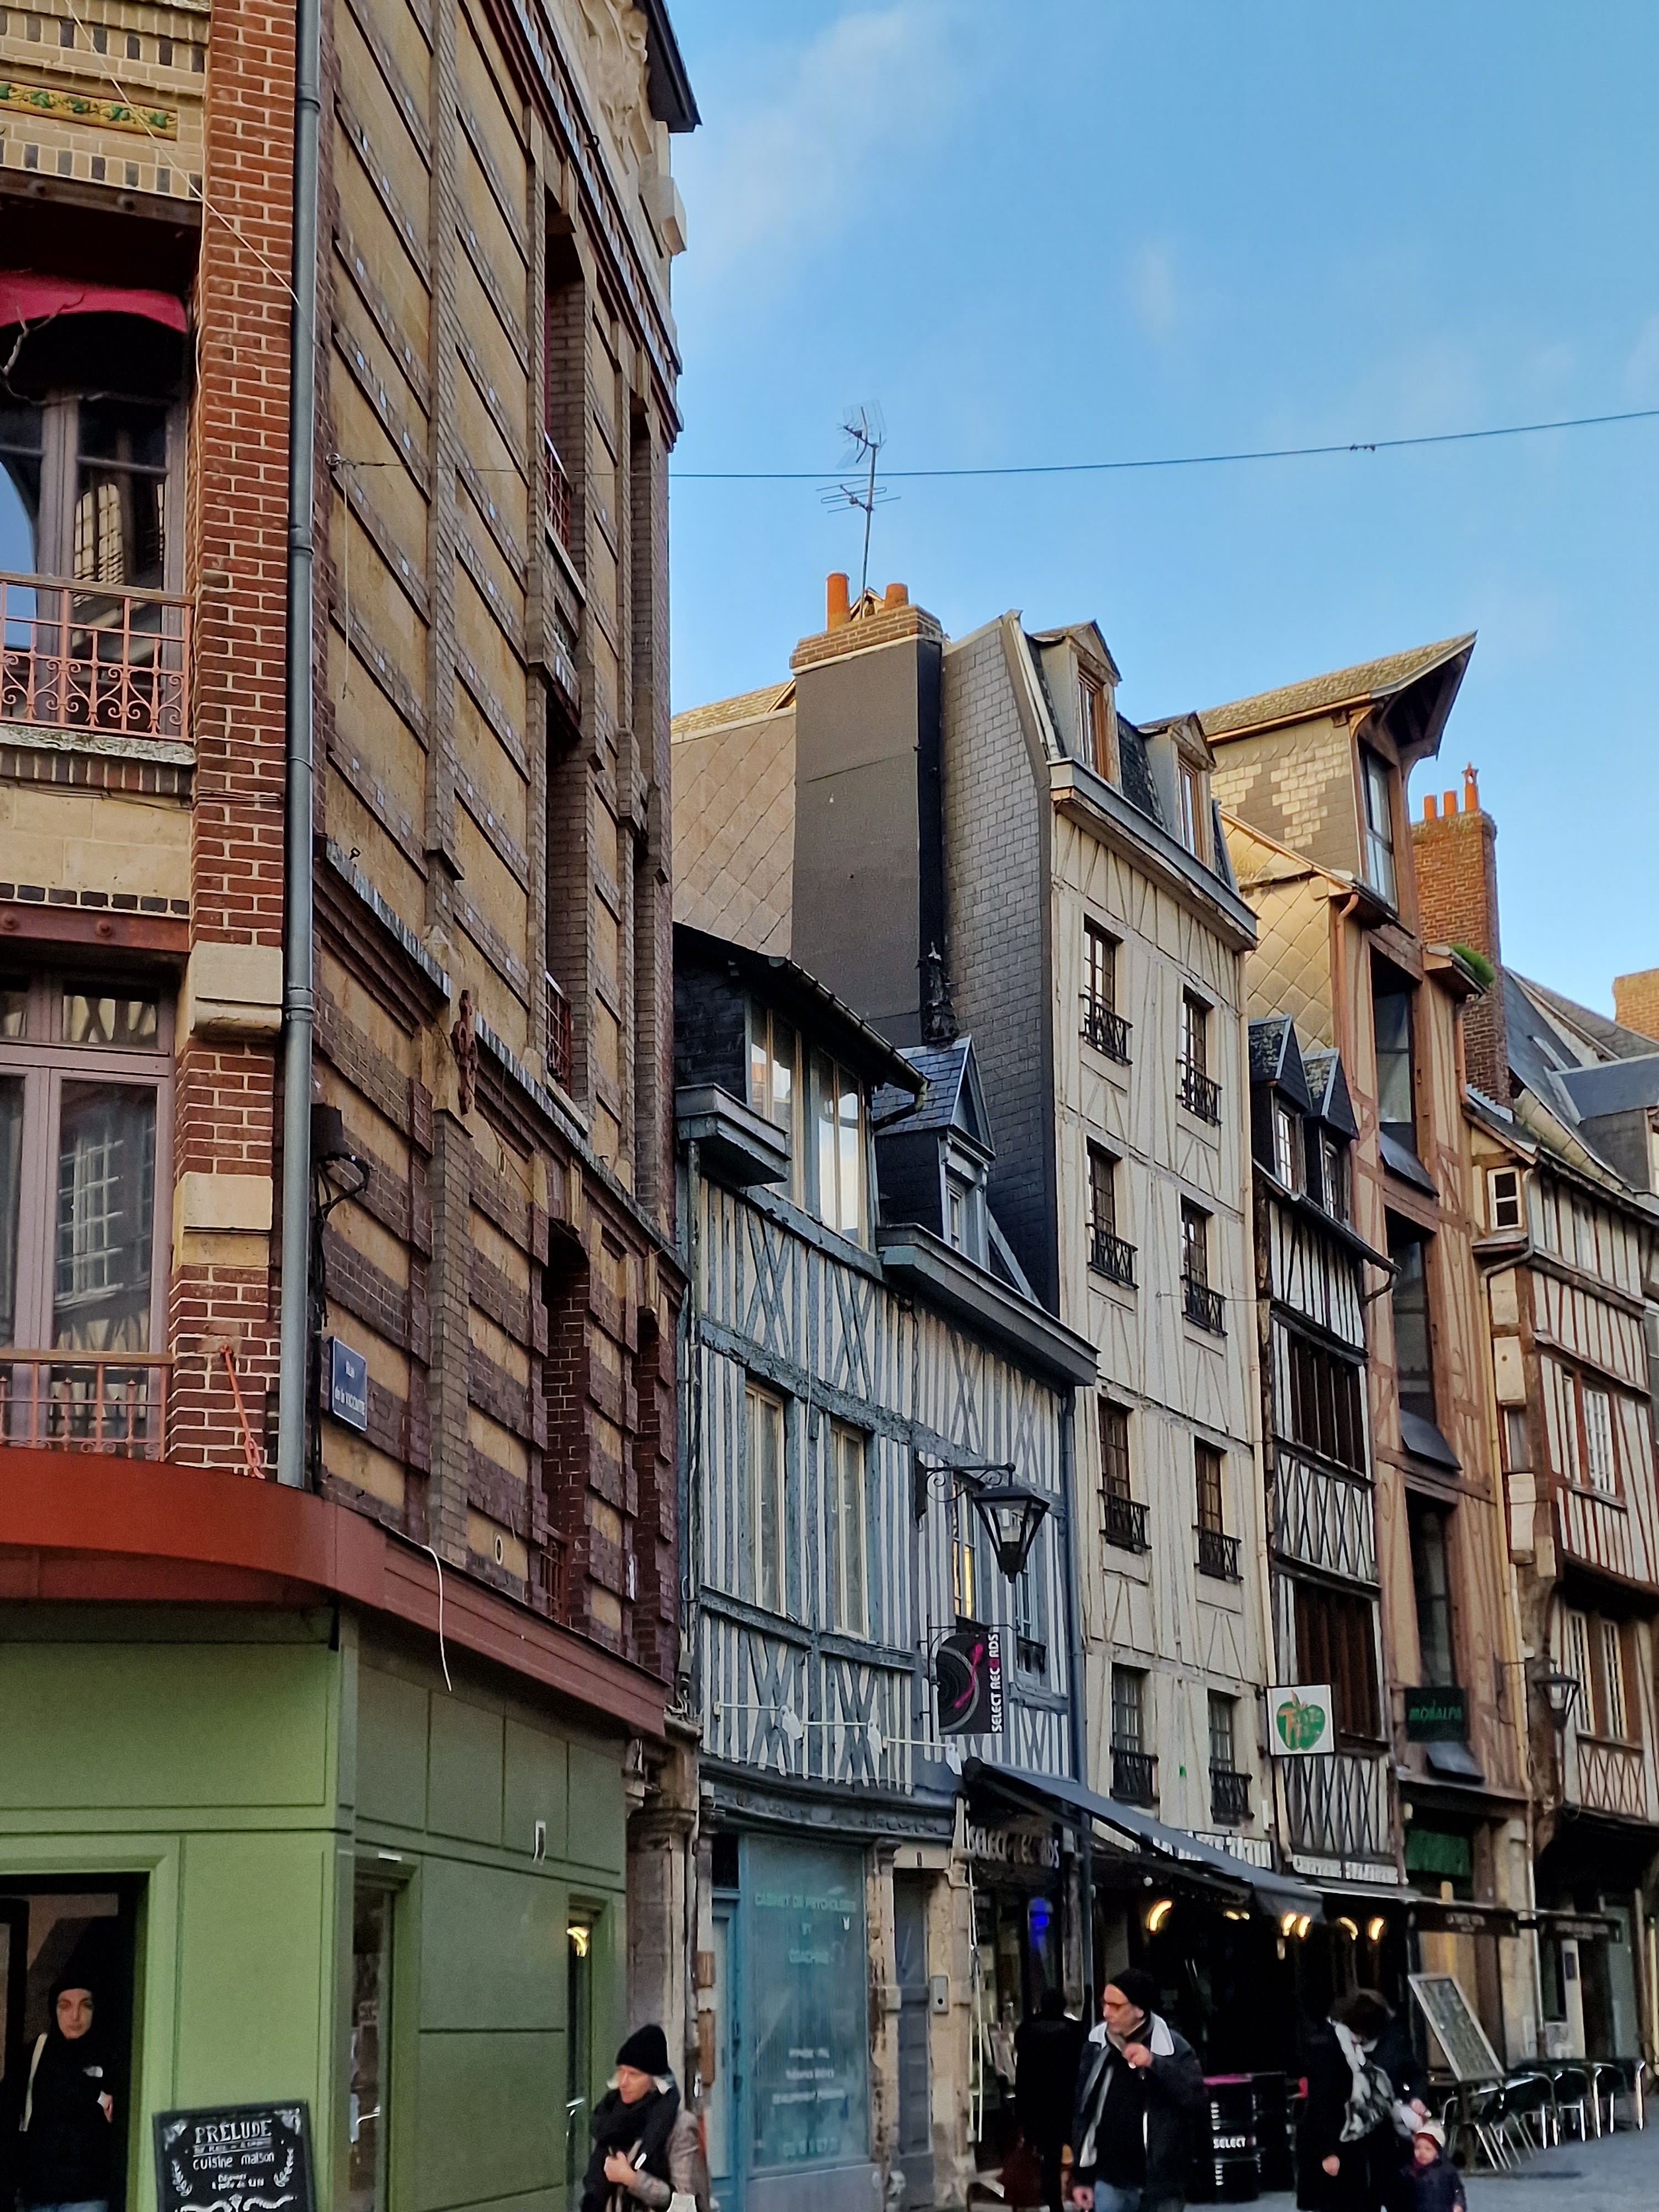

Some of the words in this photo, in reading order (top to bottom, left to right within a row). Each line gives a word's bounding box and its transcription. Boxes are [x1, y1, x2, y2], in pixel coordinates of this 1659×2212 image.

[987, 1633, 1001, 1689] RECORDS
[990, 1691, 1003, 1733] SELECT
[1213, 2136, 1246, 2149] SELECT
